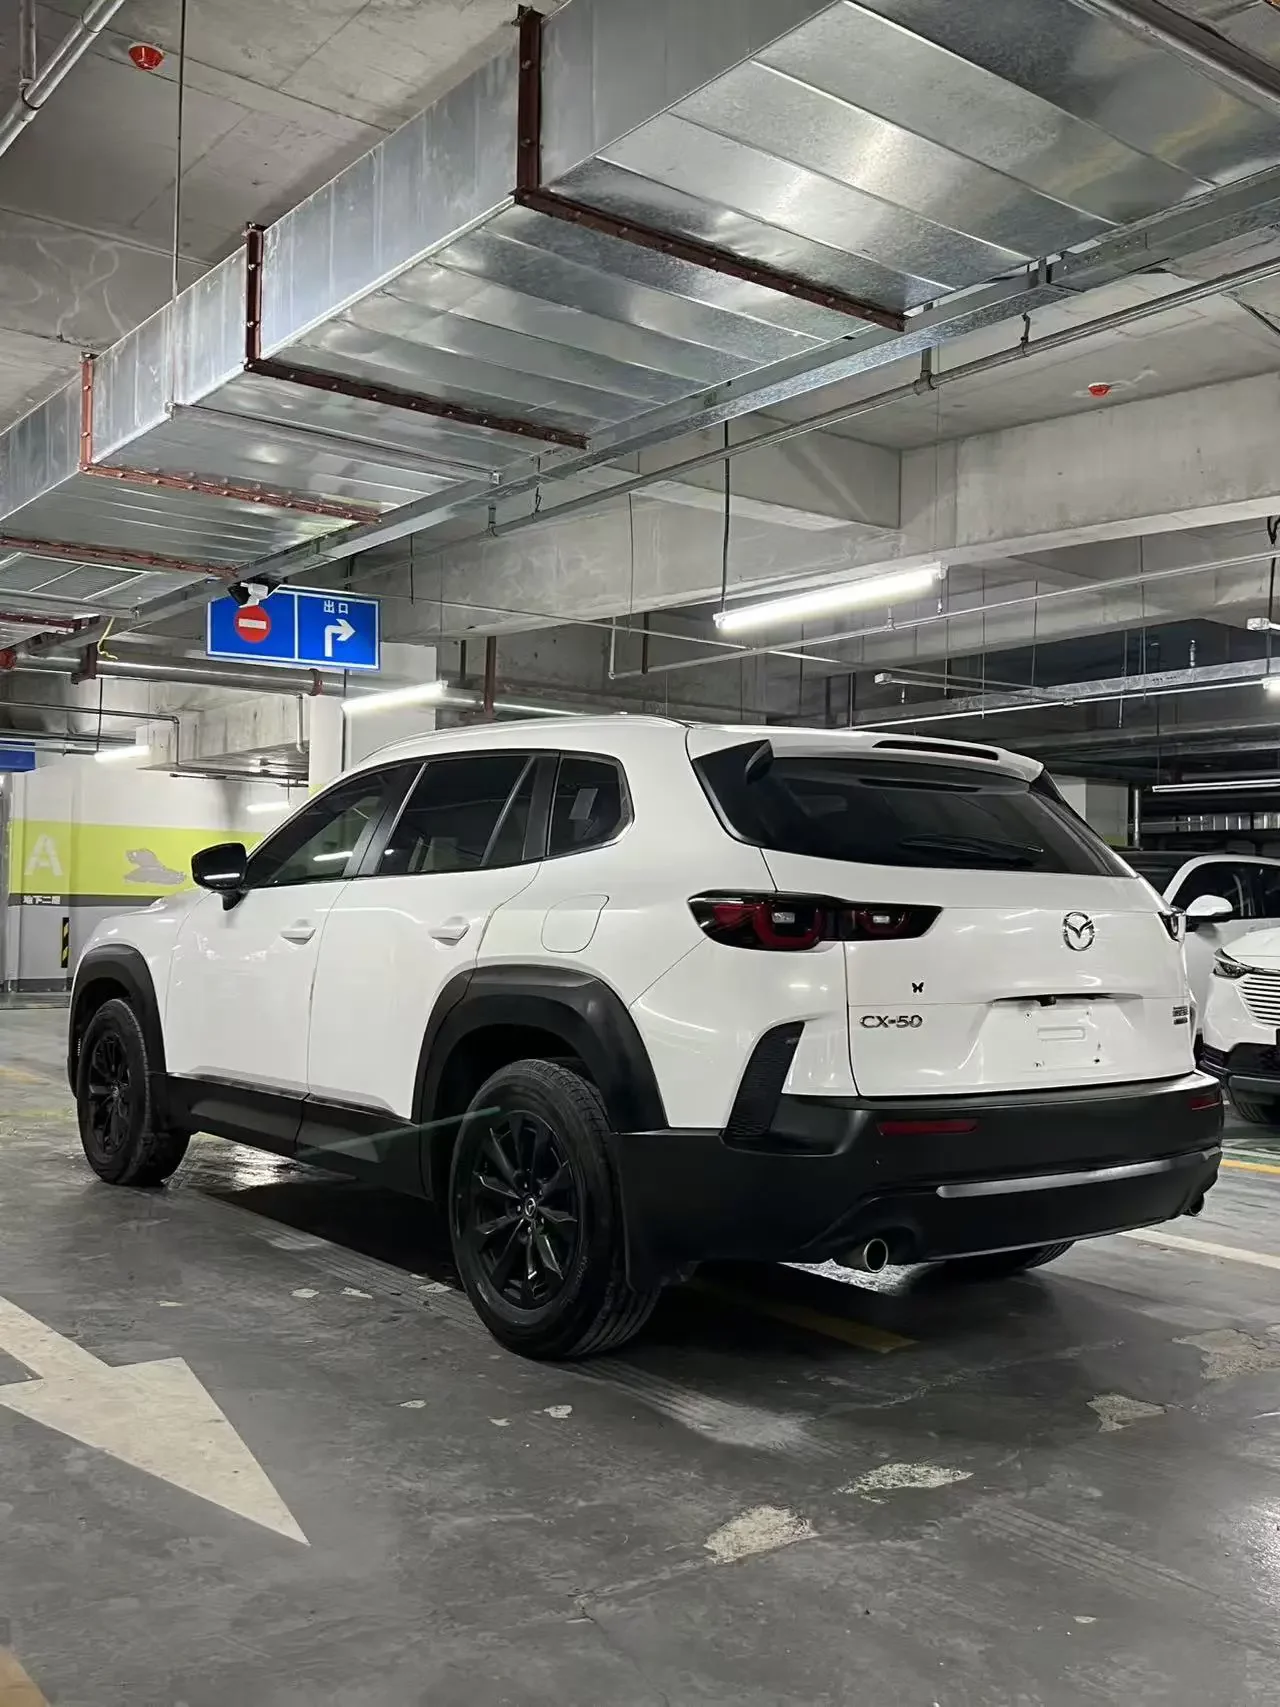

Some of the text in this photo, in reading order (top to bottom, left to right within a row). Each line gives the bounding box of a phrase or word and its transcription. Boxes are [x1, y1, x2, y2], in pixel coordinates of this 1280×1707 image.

[323, 600, 348, 614] 出口
[24, 834, 63, 876] A
[860, 1015, 923, 1028] CX-50
